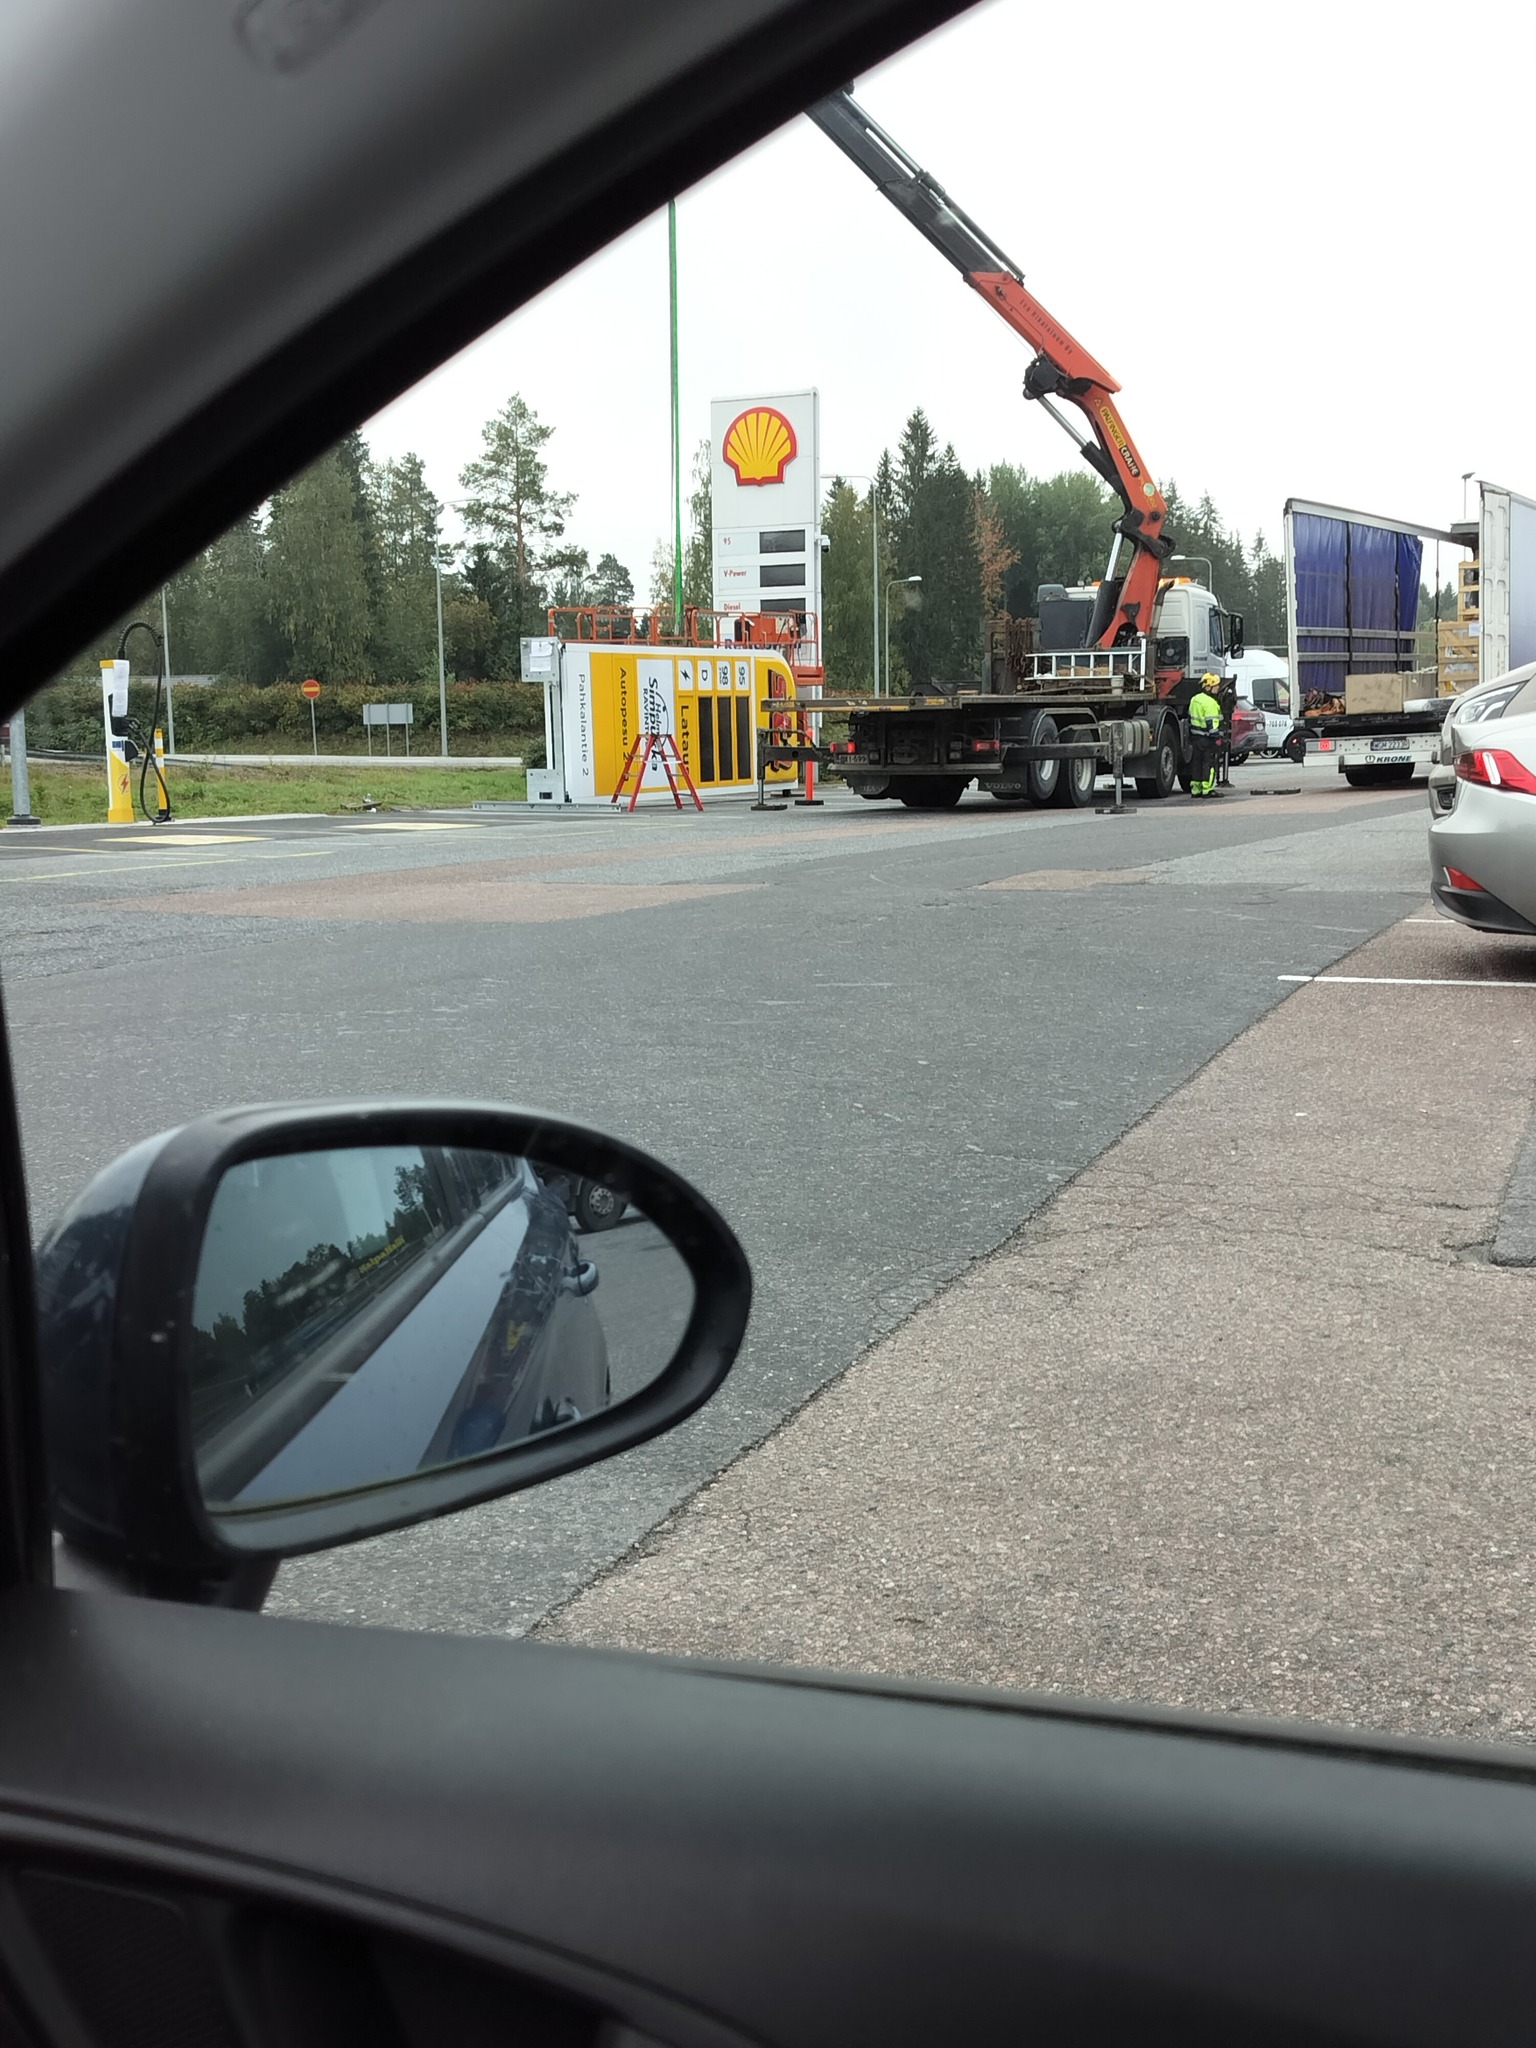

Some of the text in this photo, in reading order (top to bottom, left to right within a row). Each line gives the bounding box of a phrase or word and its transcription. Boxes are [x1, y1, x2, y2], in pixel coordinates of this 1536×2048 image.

[1101, 407, 1140, 476] PALFINGER CRANE
[723, 537, 732, 545] 95
[723, 569, 747, 578] V-Power
[723, 602, 741, 611] Diesel
[701, 669, 709, 681] D
[721, 665, 729, 686] 98
[738, 666, 746, 685] 95
[620, 667, 629, 746] Autopesu
[579, 673, 589, 777] Pahkalantie 2
[649, 676, 660, 772] Simpuka
[1376, 755, 1412, 763] KRONE
[984, 782, 1022, 790] VOLVO
